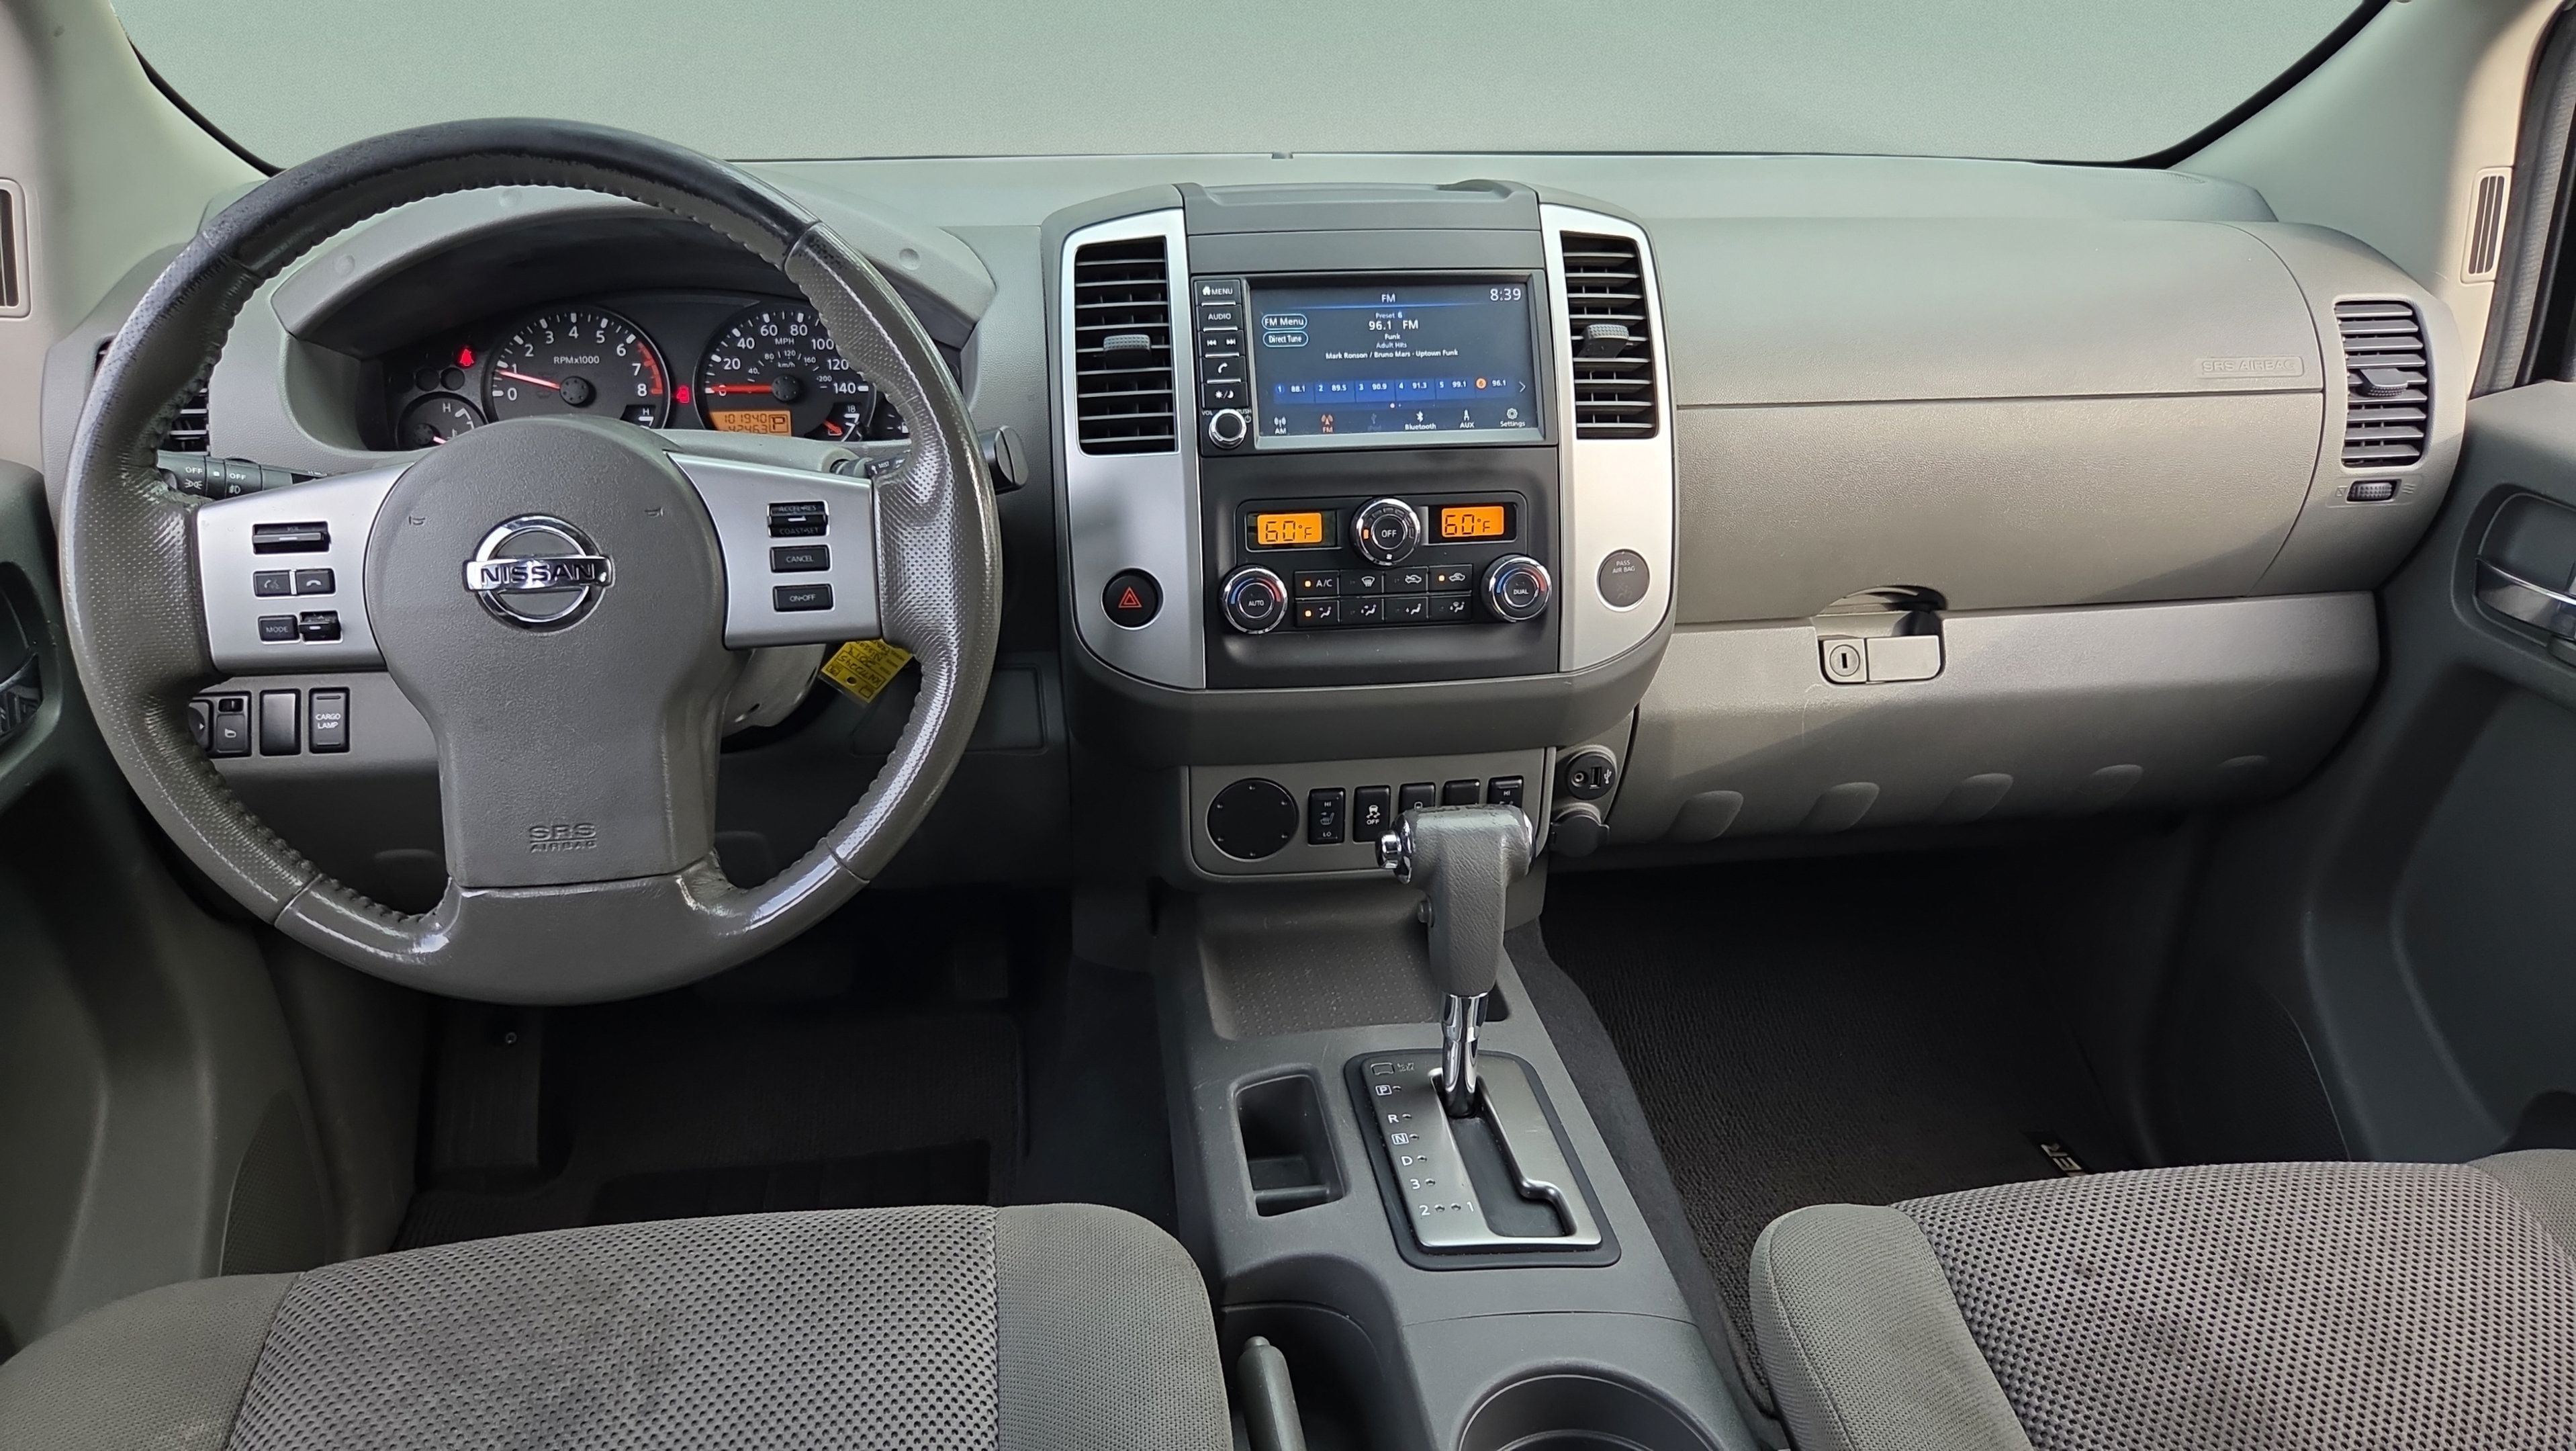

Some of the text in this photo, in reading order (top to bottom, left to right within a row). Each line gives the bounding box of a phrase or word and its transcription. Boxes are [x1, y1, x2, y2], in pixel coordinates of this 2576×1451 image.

[1381, 294, 1395, 302] FM
[1489, 288, 1522, 301] 8:39
[1264, 317, 1304, 326] FM Menu
[1368, 320, 1418, 331] 96.1 FM
[569, 326, 579, 339] 4
[760, 324, 778, 336] 60
[790, 324, 808, 336] 80
[545, 331, 554, 344] 3
[596, 331, 605, 343] 5
[737, 337, 755, 349] 40
[811, 339, 834, 350] 100
[524, 344, 534, 357] 2
[616, 343, 627, 357] 6
[1416, 350, 1442, 358] Uptown
[554, 356, 600, 364] RPMx1000
[723, 358, 741, 369] 20
[827, 359, 849, 370] 120
[2202, 359, 2295, 371] SRS AIRBAG
[512, 363, 517, 374] 1
[632, 363, 641, 376] 7
[637, 384, 647, 396] 8
[833, 382, 856, 394] 140
[508, 388, 517, 400] 0
[443, 403, 451, 412] H
[725, 413, 767, 424] 101940
[772, 416, 785, 430] P
[1381, 529, 1397, 537] OFF
[481, 564, 595, 585] NISSAN
[1316, 579, 1332, 587] A/C
[316, 713, 340, 721] CARGO
[529, 823, 596, 840] SRS
[1387, 1114, 1399, 1123] R
[1401, 1156, 1413, 1166] D
[1410, 1179, 1421, 1190] 3
[1419, 1204, 1430, 1215] 2
[1467, 1201, 1474, 1212] 1
